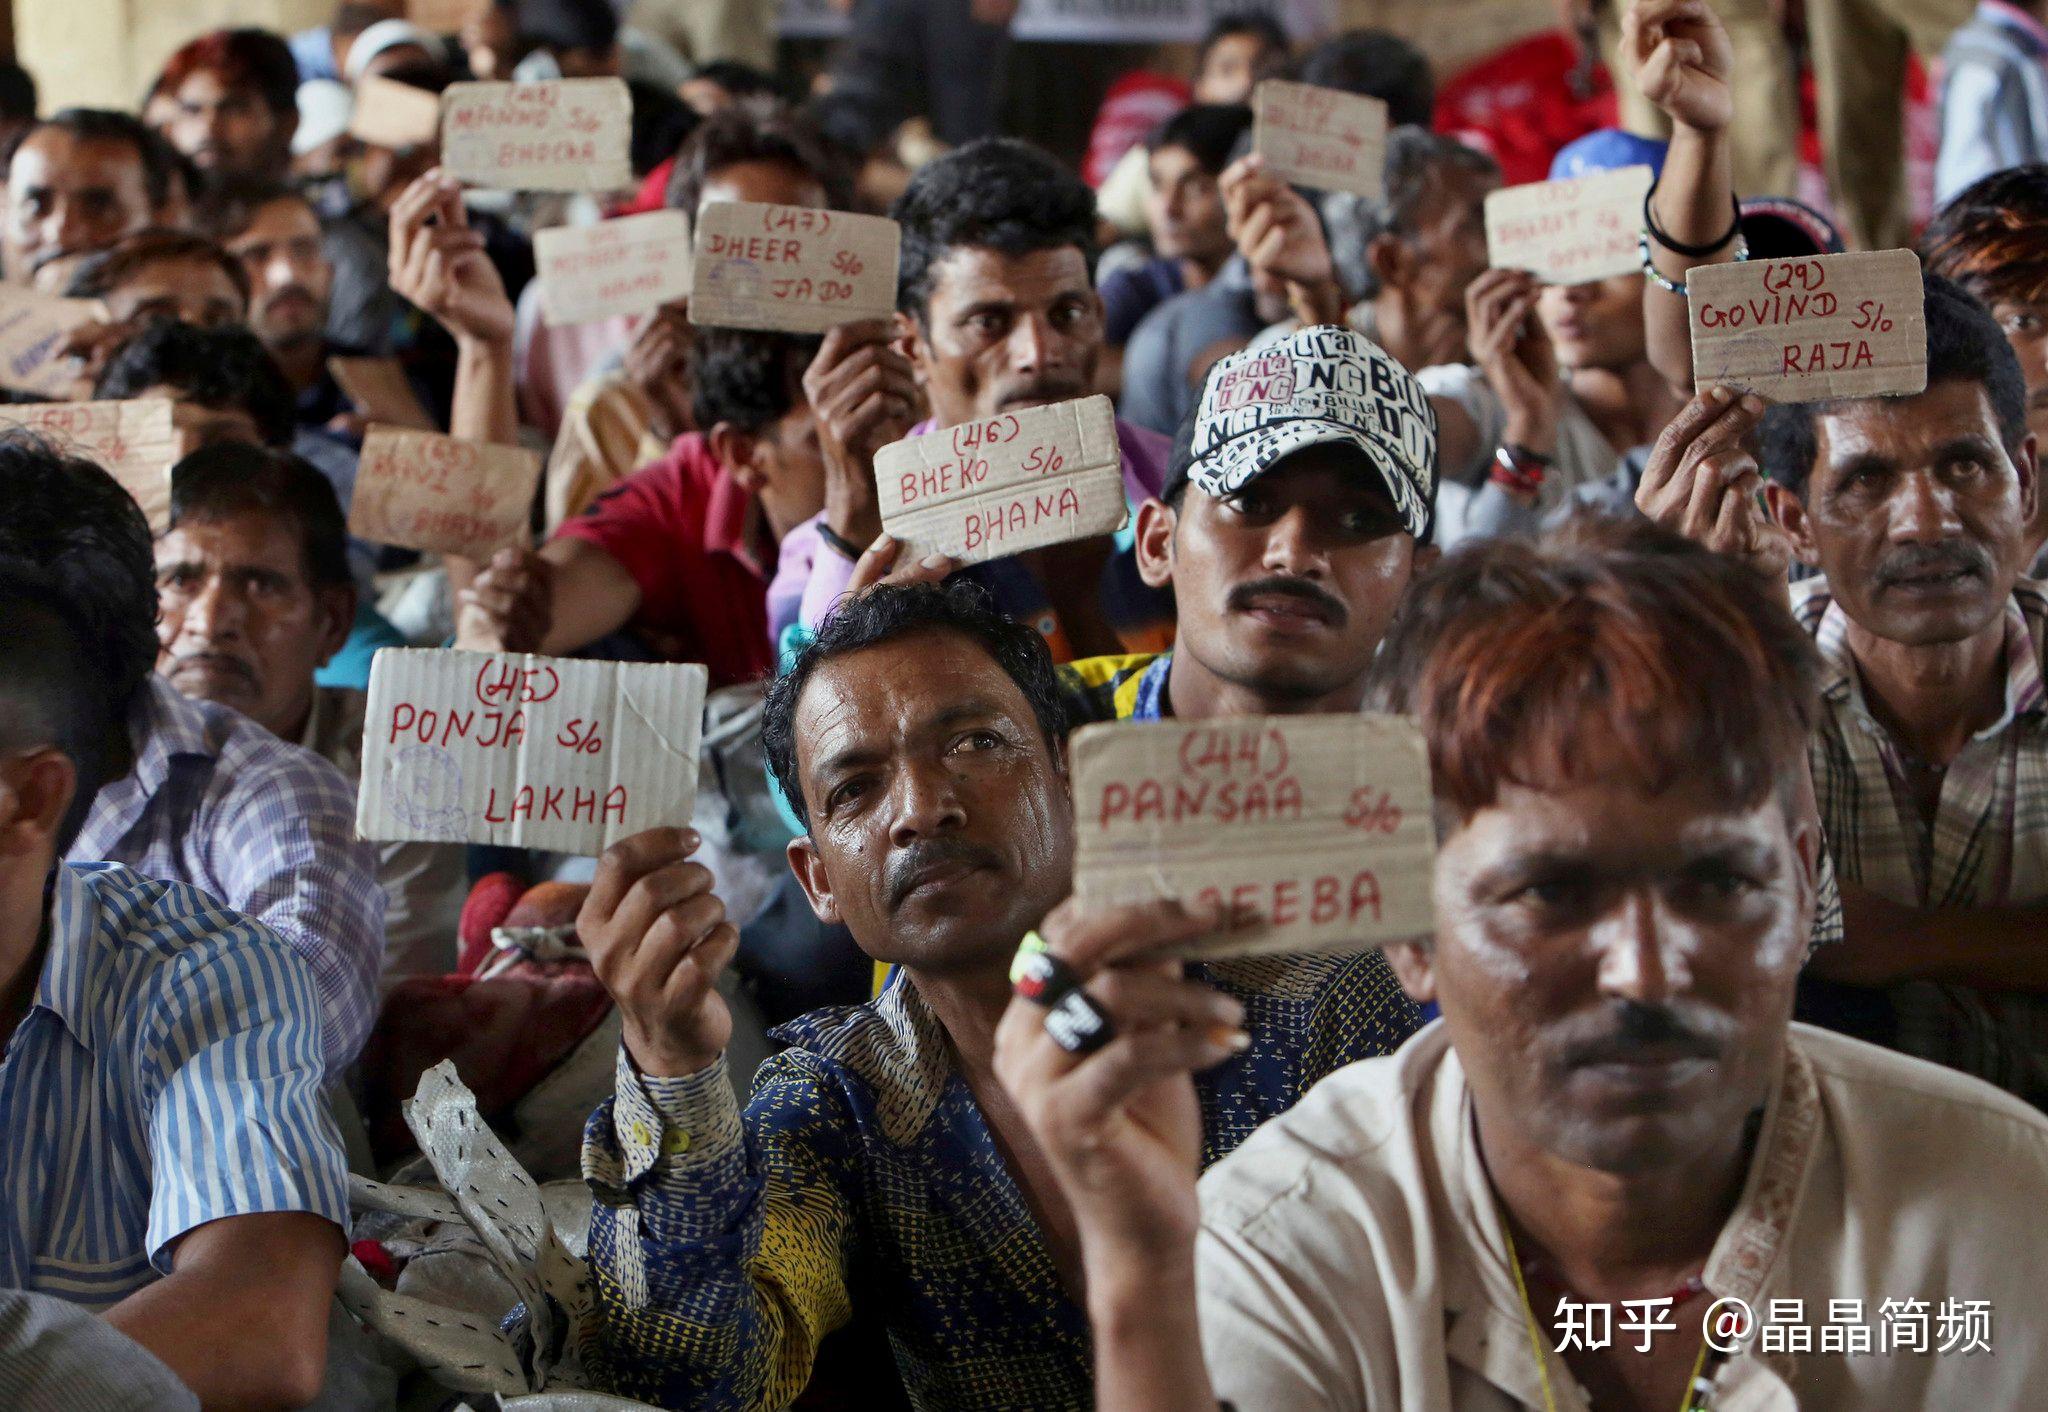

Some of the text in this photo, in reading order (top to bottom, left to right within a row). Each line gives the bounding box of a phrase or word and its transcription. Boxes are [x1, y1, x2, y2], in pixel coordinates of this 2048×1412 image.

[764, 208, 831, 236] (47)
[706, 234, 864, 276] DHEER S/o
[771, 278, 854, 302] JADO
[1763, 260, 1825, 294] (29)
[1700, 292, 1893, 332] GOVIND S/o
[1783, 340, 1874, 377] RAJA
[953, 415, 1019, 456] (46)
[901, 446, 1064, 504] BHEKO S/o
[965, 488, 1079, 550] BHANA
[476, 658, 559, 706] (45)
[390, 703, 602, 753] PONJA S/o
[1178, 728, 1289, 782] (44)
[484, 785, 627, 824] LAKHA
[1100, 776, 1402, 834] PANSAA S/o
